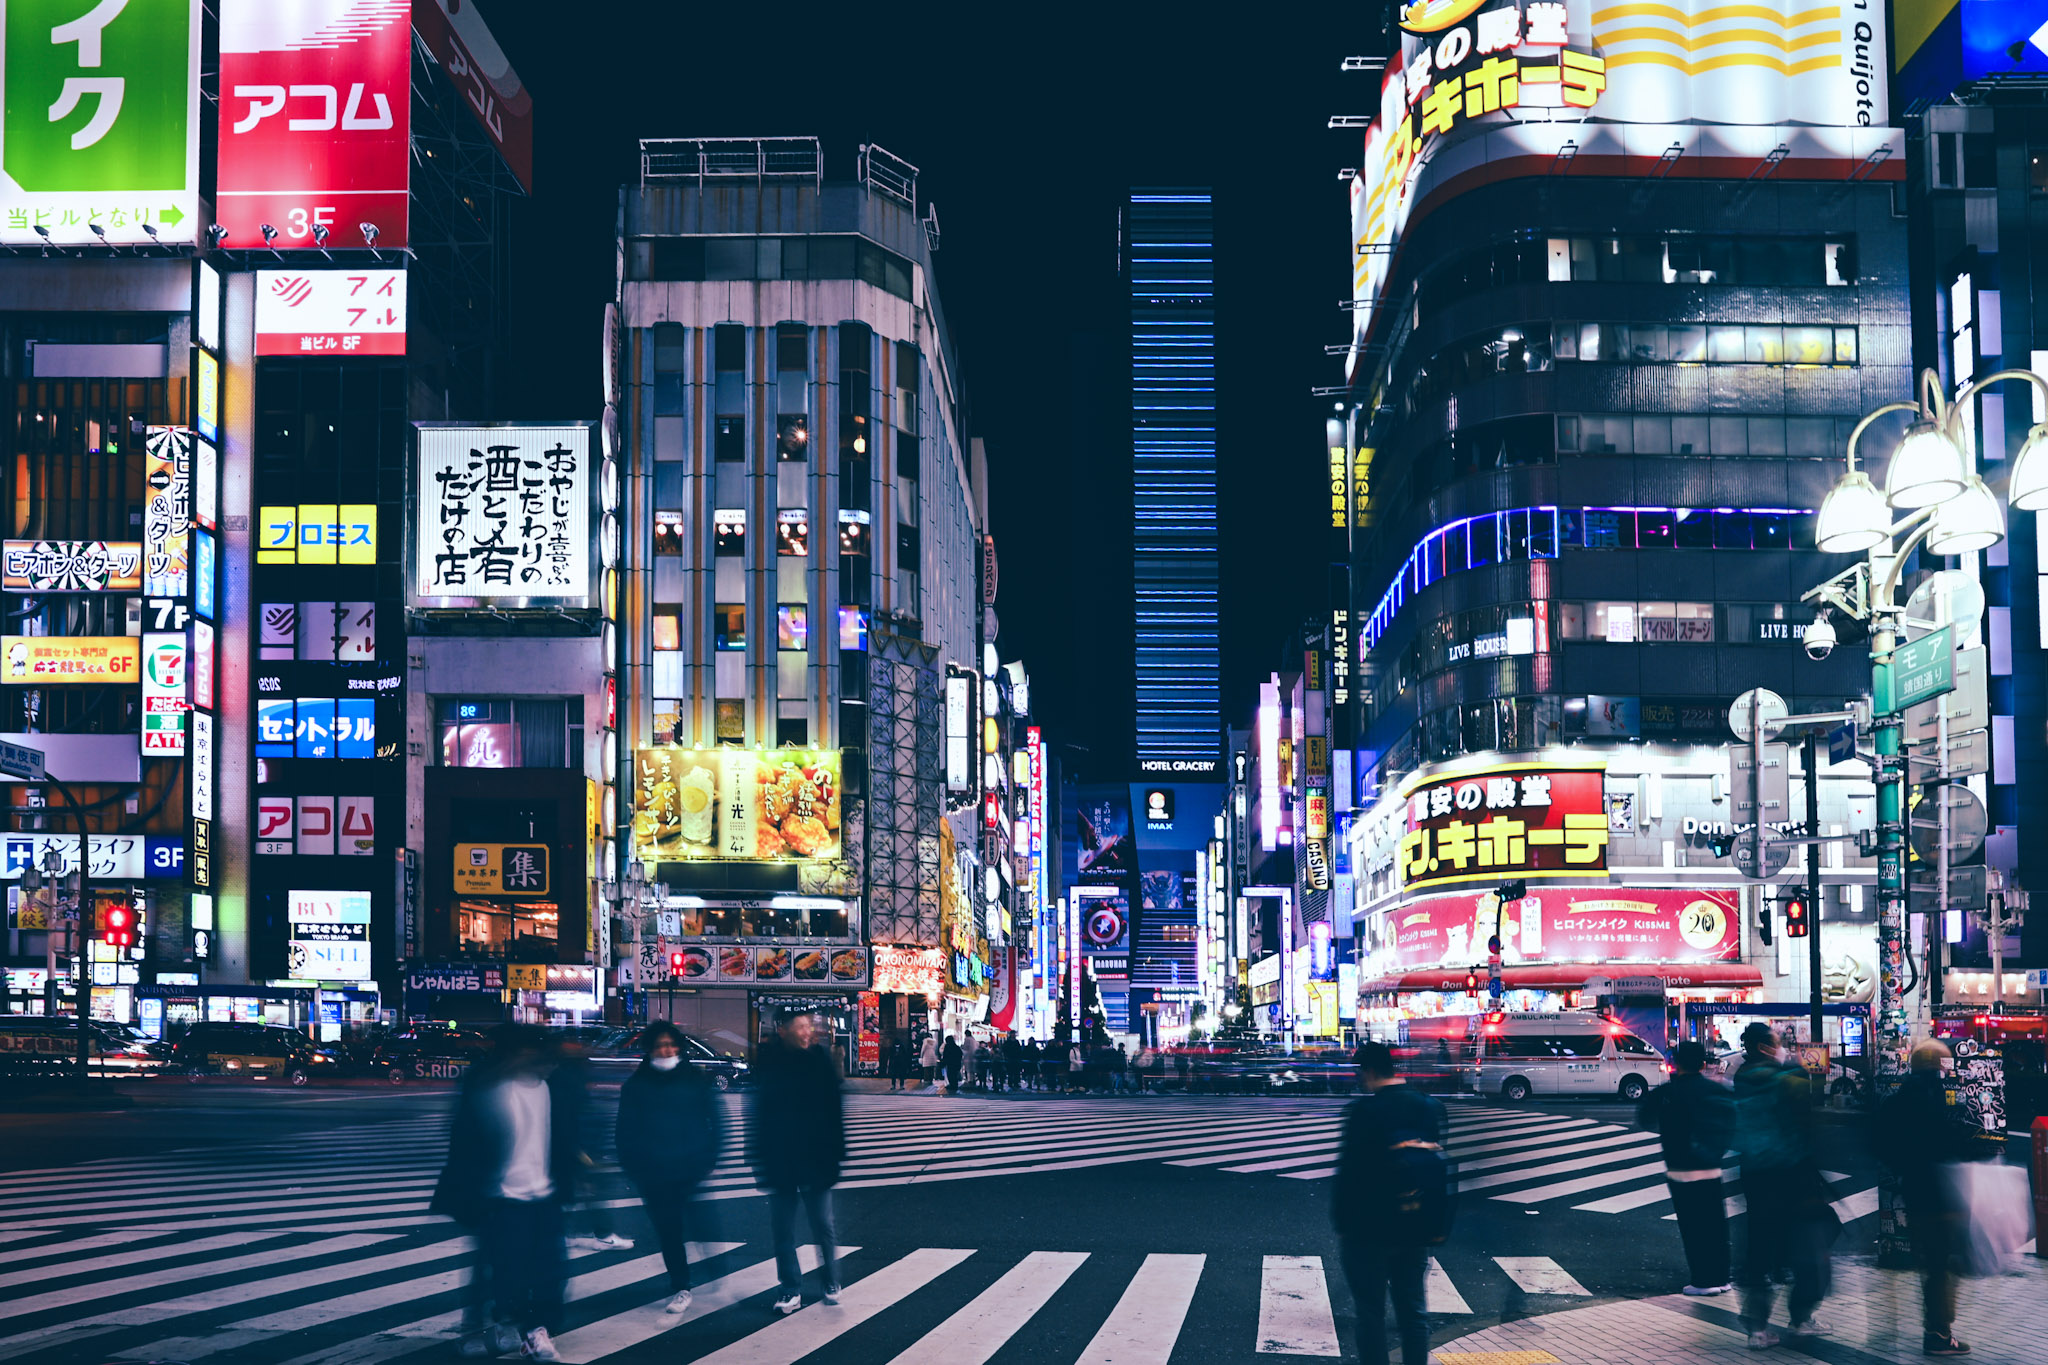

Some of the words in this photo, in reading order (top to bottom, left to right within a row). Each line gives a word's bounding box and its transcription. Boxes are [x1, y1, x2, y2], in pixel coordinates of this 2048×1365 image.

[1850, 20, 1874, 127] Quijote
[233, 83, 394, 134] アコム
[7, 205, 151, 230] 当ビルとなり
[287, 207, 336, 239] 3F
[300, 336, 337, 350] 当ビル
[342, 336, 362, 350] 5F
[433, 465, 472, 586] だけの店
[519, 461, 548, 583] こだわりの
[269, 520, 372, 545] プロミス
[149, 600, 190, 629] 7F
[1609, 621, 1632, 638] 新宿
[1679, 619, 1712, 638] ステージ
[1760, 623, 1788, 638] LIVE
[1449, 643, 1471, 661] LIVE
[1474, 636, 1508, 655] HOUSE
[1902, 636, 1944, 669] モア
[109, 656, 133, 673] 6F
[1903, 667, 1943, 695] 靖国通り
[1641, 705, 1676, 722] 販売
[259, 715, 375, 742] セントラル
[148, 733, 185, 748] ATM
[312, 746, 327, 756] 4F
[1142, 761, 1172, 771] HOTEL
[1172, 761, 1215, 771] GRACERY
[1310, 788, 1323, 797] 4F
[258, 806, 374, 837] アコム
[1309, 798, 1325, 826] 麻雀
[1683, 817, 1726, 835] Don
[266, 843, 284, 853] 3F
[730, 841, 745, 853] 4F
[153, 846, 185, 868] 3F
[1307, 842, 1327, 887] CASINO
[505, 850, 542, 888] 集
[298, 902, 334, 916] BUY
[1553, 918, 1628, 931] ヒロインメイク
[315, 947, 364, 962] SELL
[874, 953, 947, 970] OKONOMIYAKI
[1441, 980, 1463, 990] Don
[1845, 1021, 1854, 1035] P
